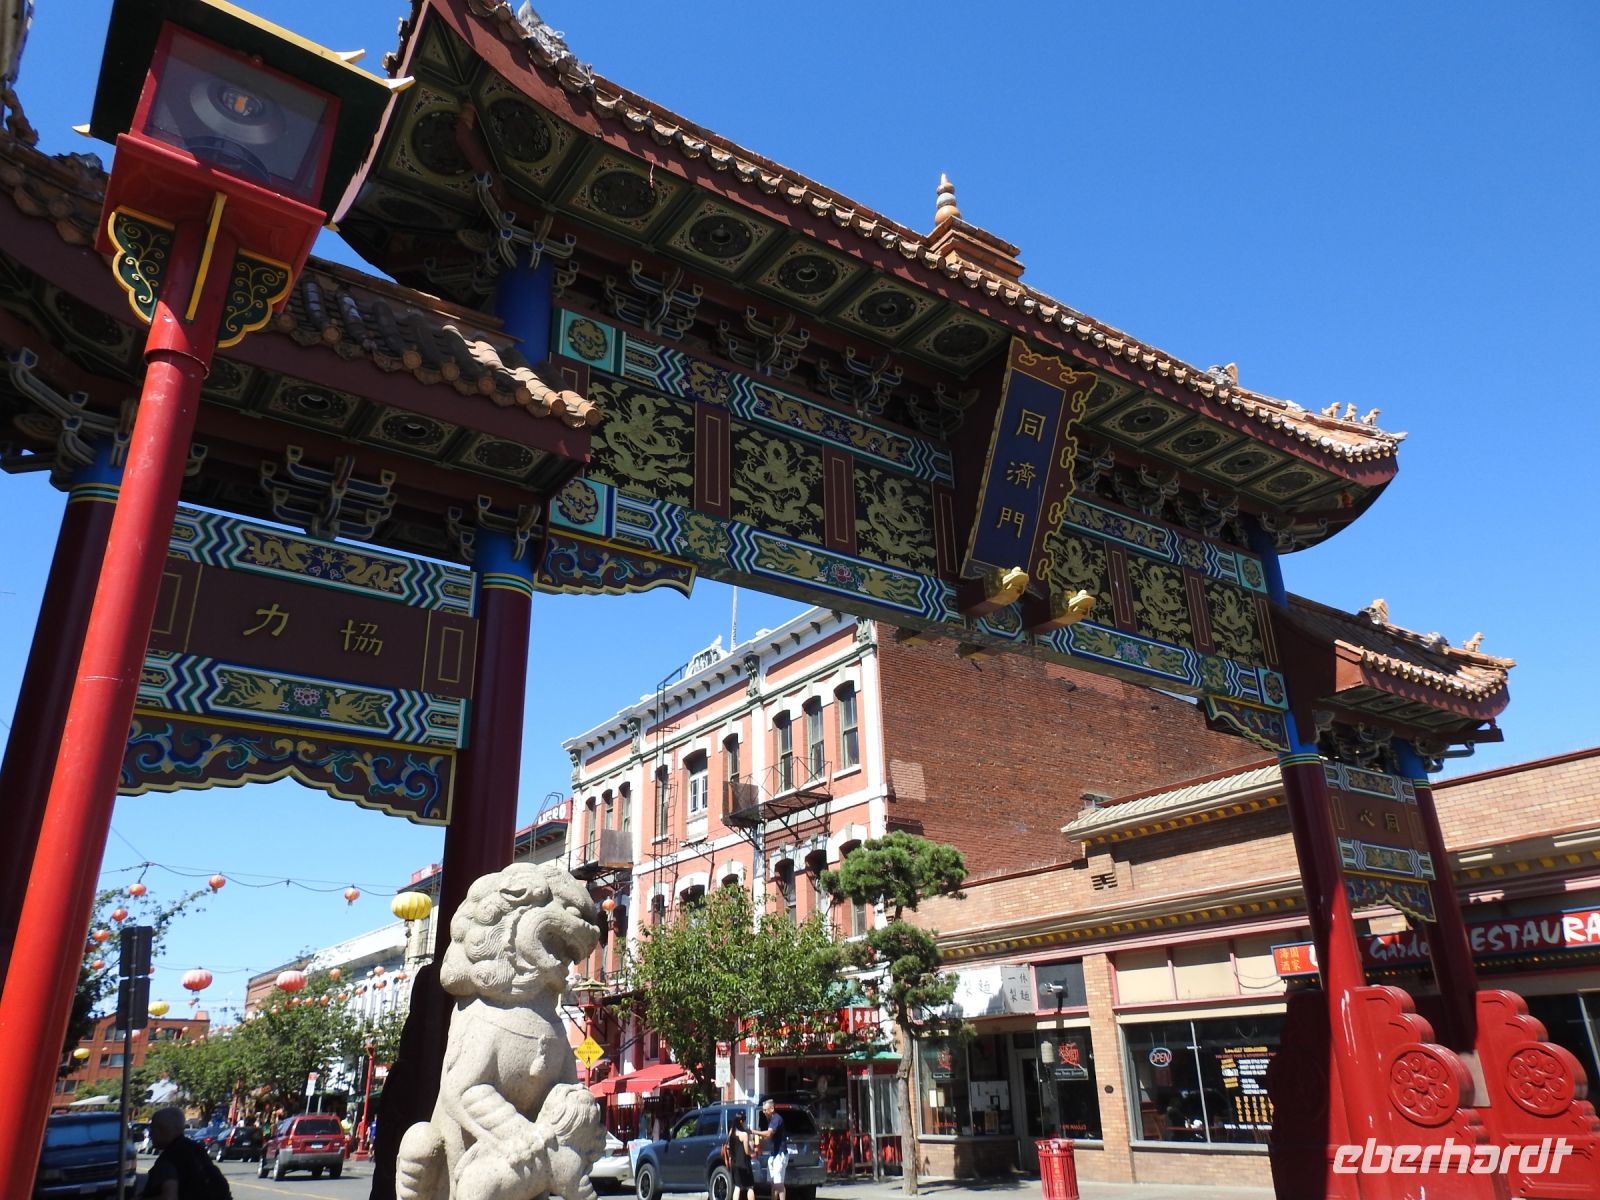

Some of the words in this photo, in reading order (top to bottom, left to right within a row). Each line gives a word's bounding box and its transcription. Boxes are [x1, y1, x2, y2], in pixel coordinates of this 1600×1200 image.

[996, 408, 1047, 539] 同濟門
[1369, 933, 1430, 961] Garde
[1471, 912, 1600, 952] ESTAURA
[1151, 1052, 1169, 1063] OPEN
